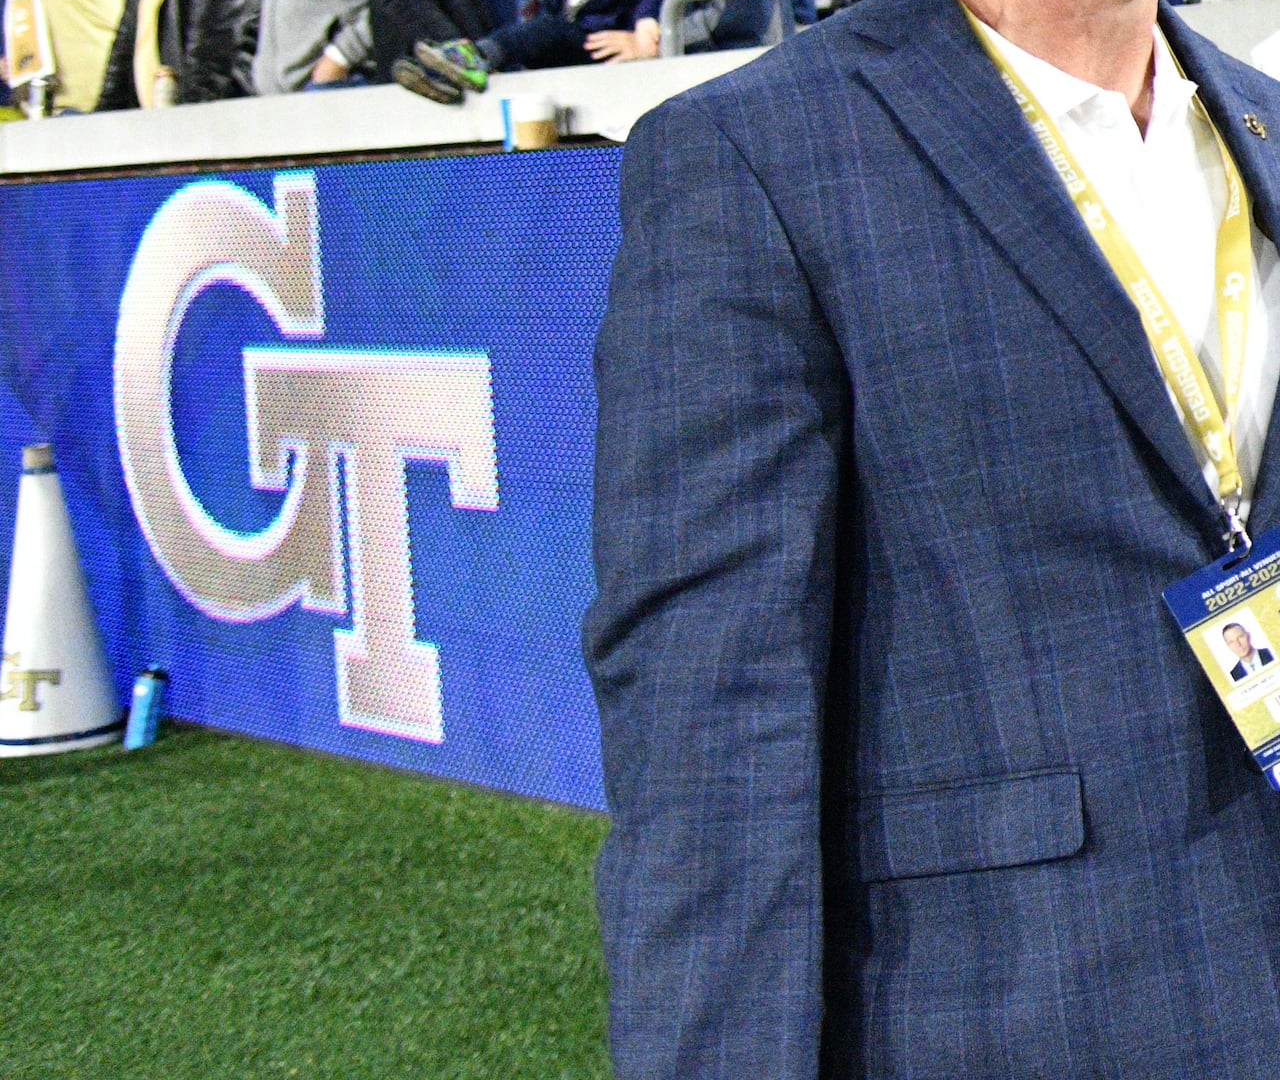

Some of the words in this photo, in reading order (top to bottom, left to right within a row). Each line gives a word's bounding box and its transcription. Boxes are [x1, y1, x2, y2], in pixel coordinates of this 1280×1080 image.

[1129, 278, 1170, 334] TECH
[1161, 334, 1210, 423] GEORGIA
[113, 168, 500, 744] GT
[1201, 588, 1217, 600] ALL
